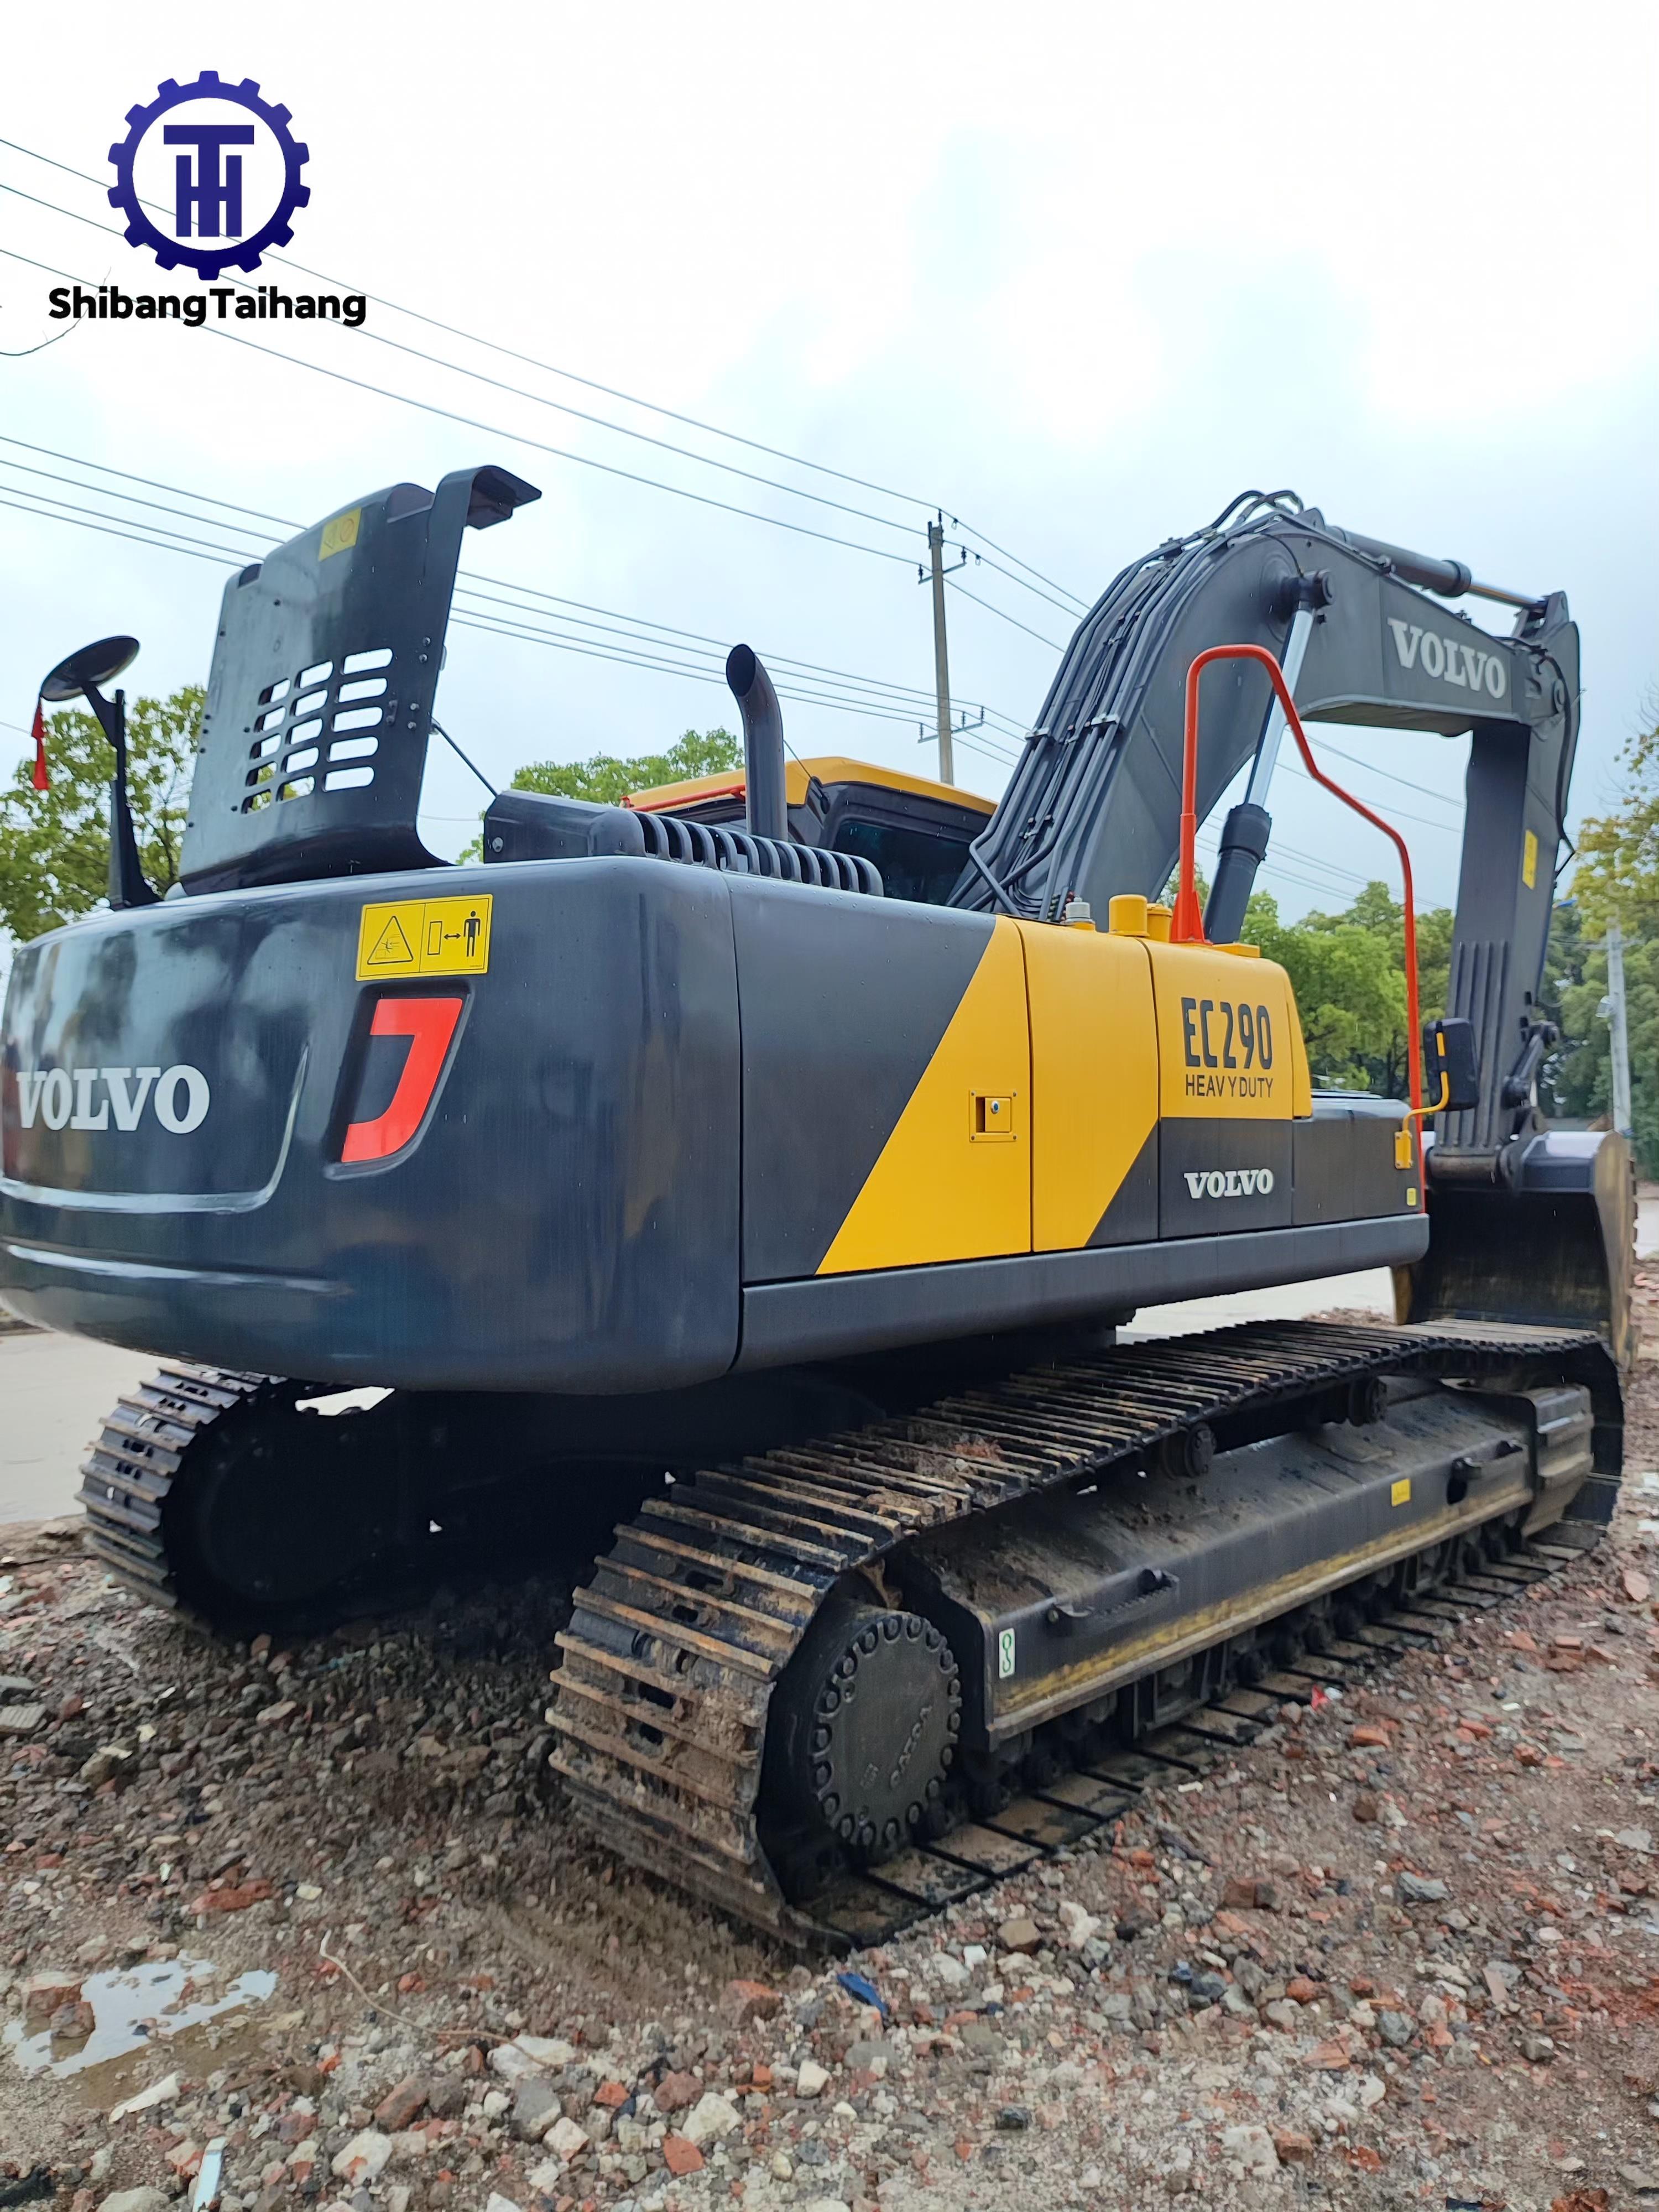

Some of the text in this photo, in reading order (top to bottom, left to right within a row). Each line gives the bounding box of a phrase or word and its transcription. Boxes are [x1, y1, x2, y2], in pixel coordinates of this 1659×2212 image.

[1388, 618, 1505, 698] VOLVO
[1181, 997, 1272, 1070] EC290
[15, 1065, 210, 1134] VOLVO
[1183, 1168, 1274, 1199] VOLVO
